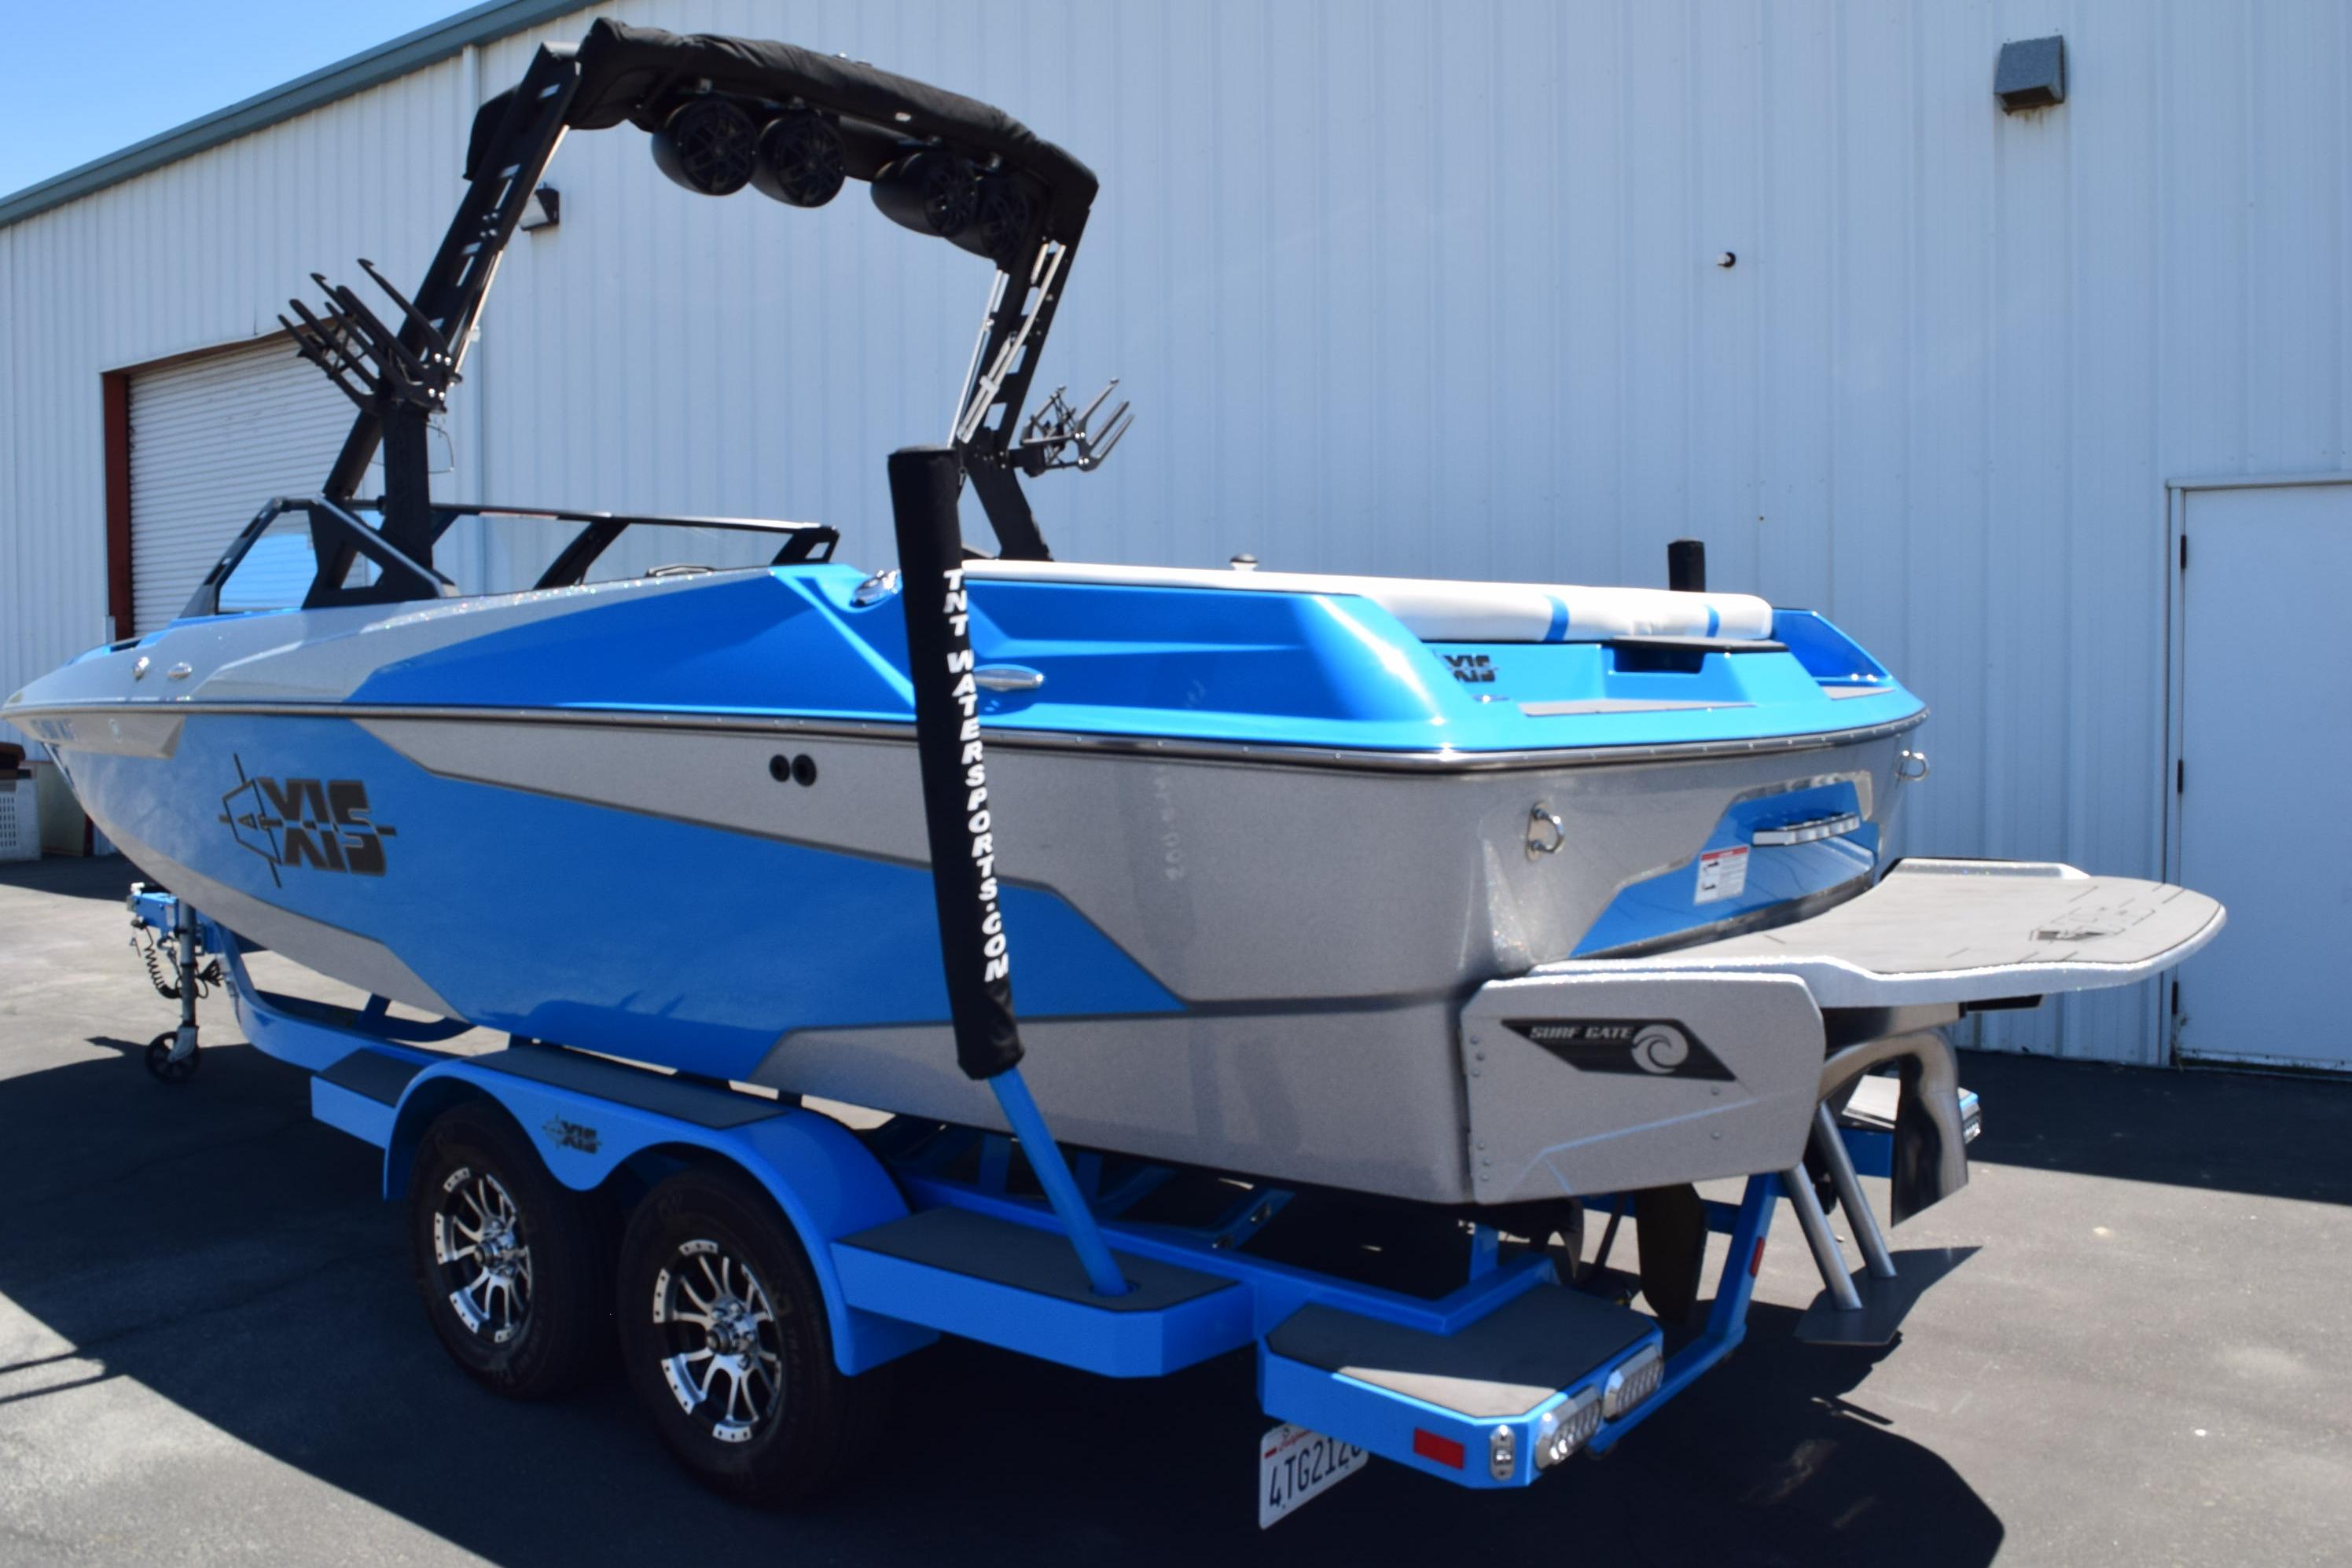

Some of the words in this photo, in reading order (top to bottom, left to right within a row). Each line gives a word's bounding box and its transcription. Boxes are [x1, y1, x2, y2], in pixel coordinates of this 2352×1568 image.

[943, 568, 968, 637] TNT
[1530, 1025, 1581, 1039] SURF
[1585, 1025, 1634, 1039] GATE
